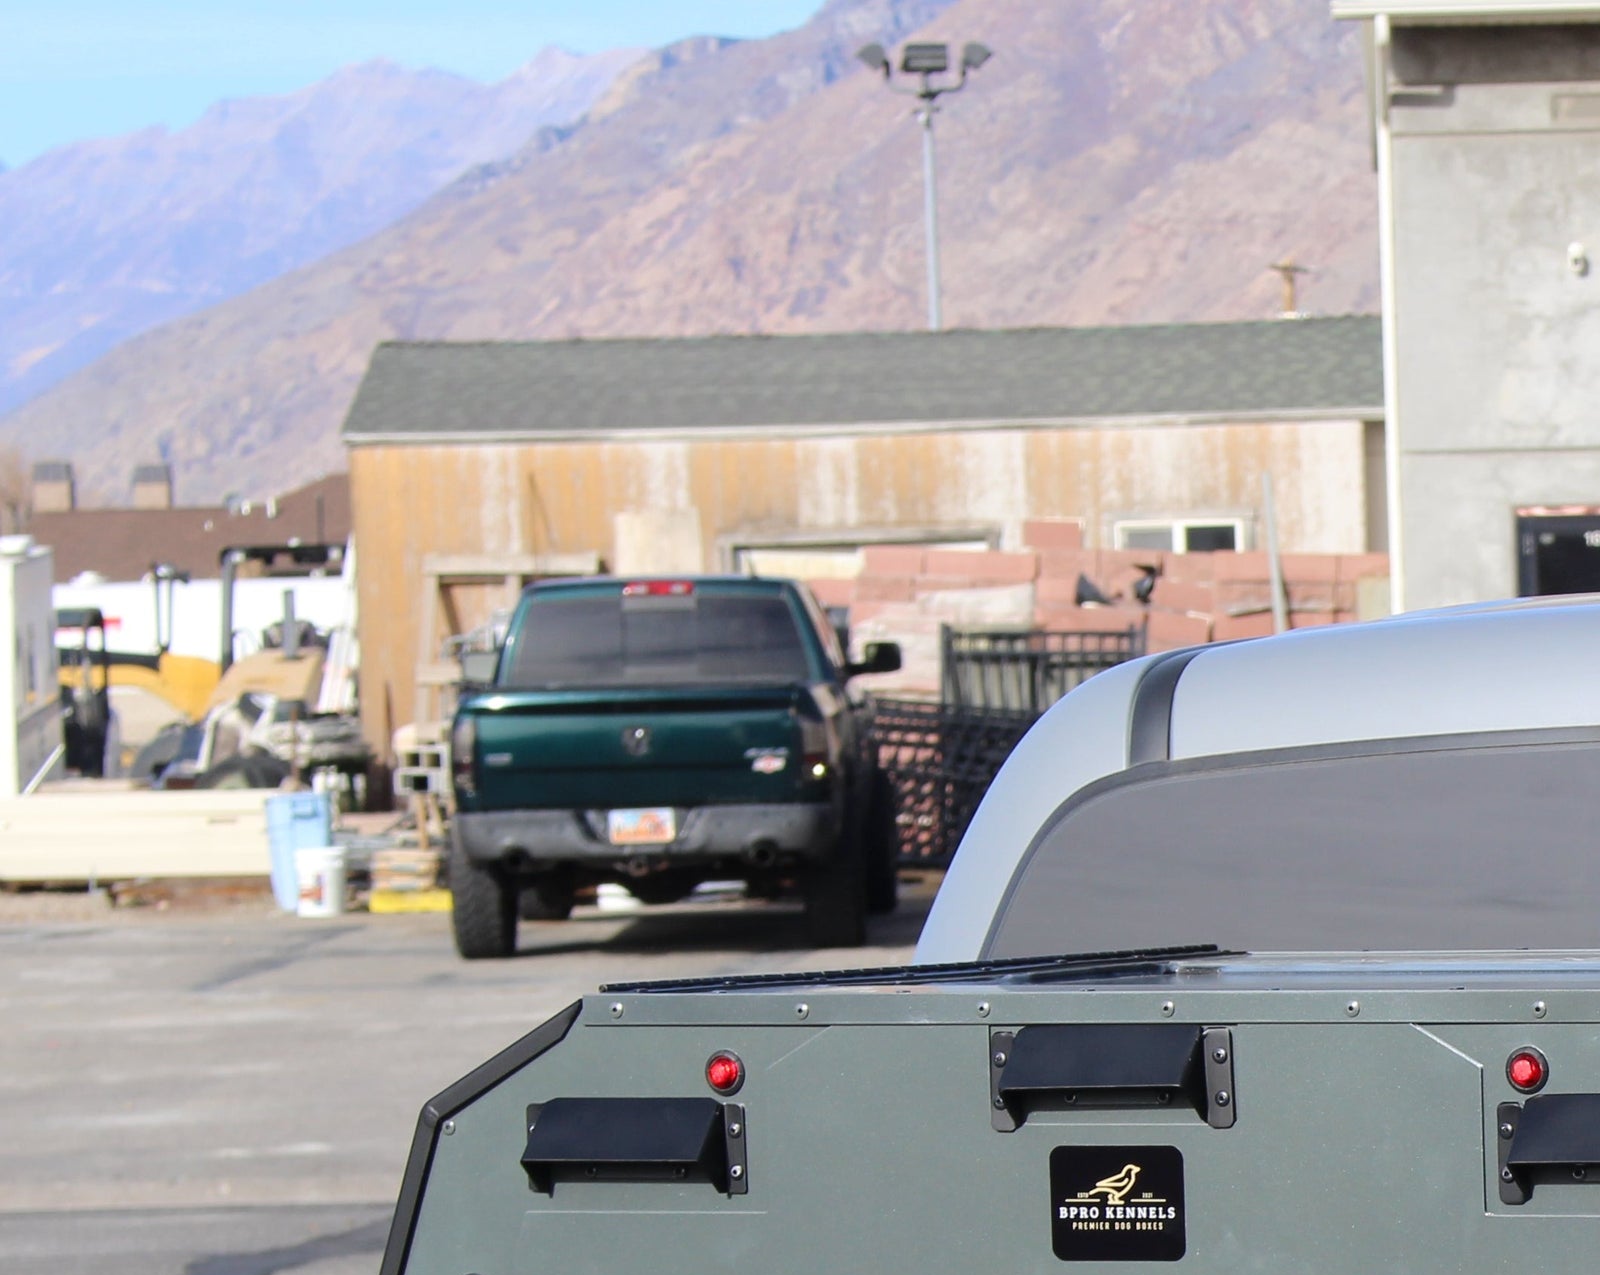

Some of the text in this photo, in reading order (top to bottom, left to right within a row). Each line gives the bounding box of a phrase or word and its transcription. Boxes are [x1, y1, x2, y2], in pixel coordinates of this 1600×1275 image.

[1059, 1206, 1176, 1219] BPRO KENNELS
[1072, 1222, 1164, 1230] PREMIER DOG BOXES
